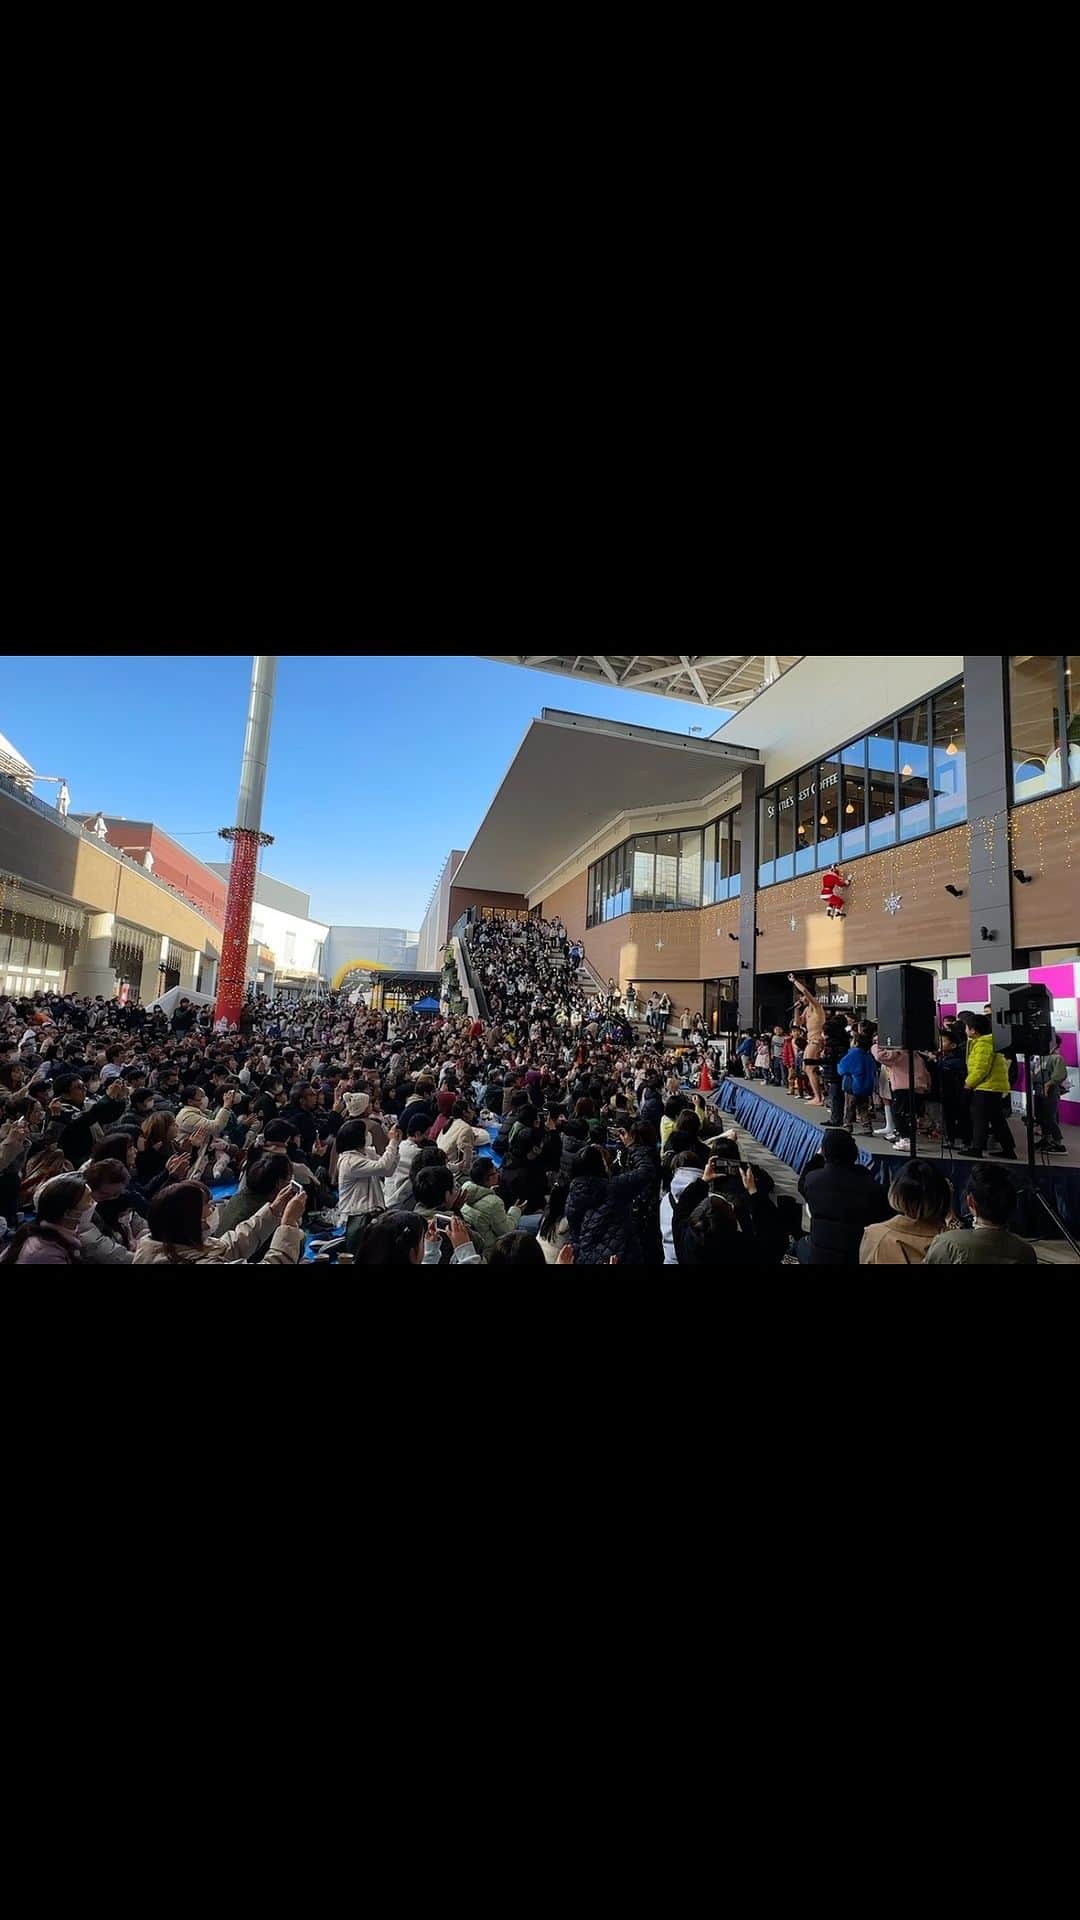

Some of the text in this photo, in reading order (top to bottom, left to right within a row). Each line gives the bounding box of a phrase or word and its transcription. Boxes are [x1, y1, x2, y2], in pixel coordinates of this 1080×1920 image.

[768, 795, 794, 818] SETTLE'S
[798, 787, 810, 801] EST
[831, 993, 849, 1004] Mall
